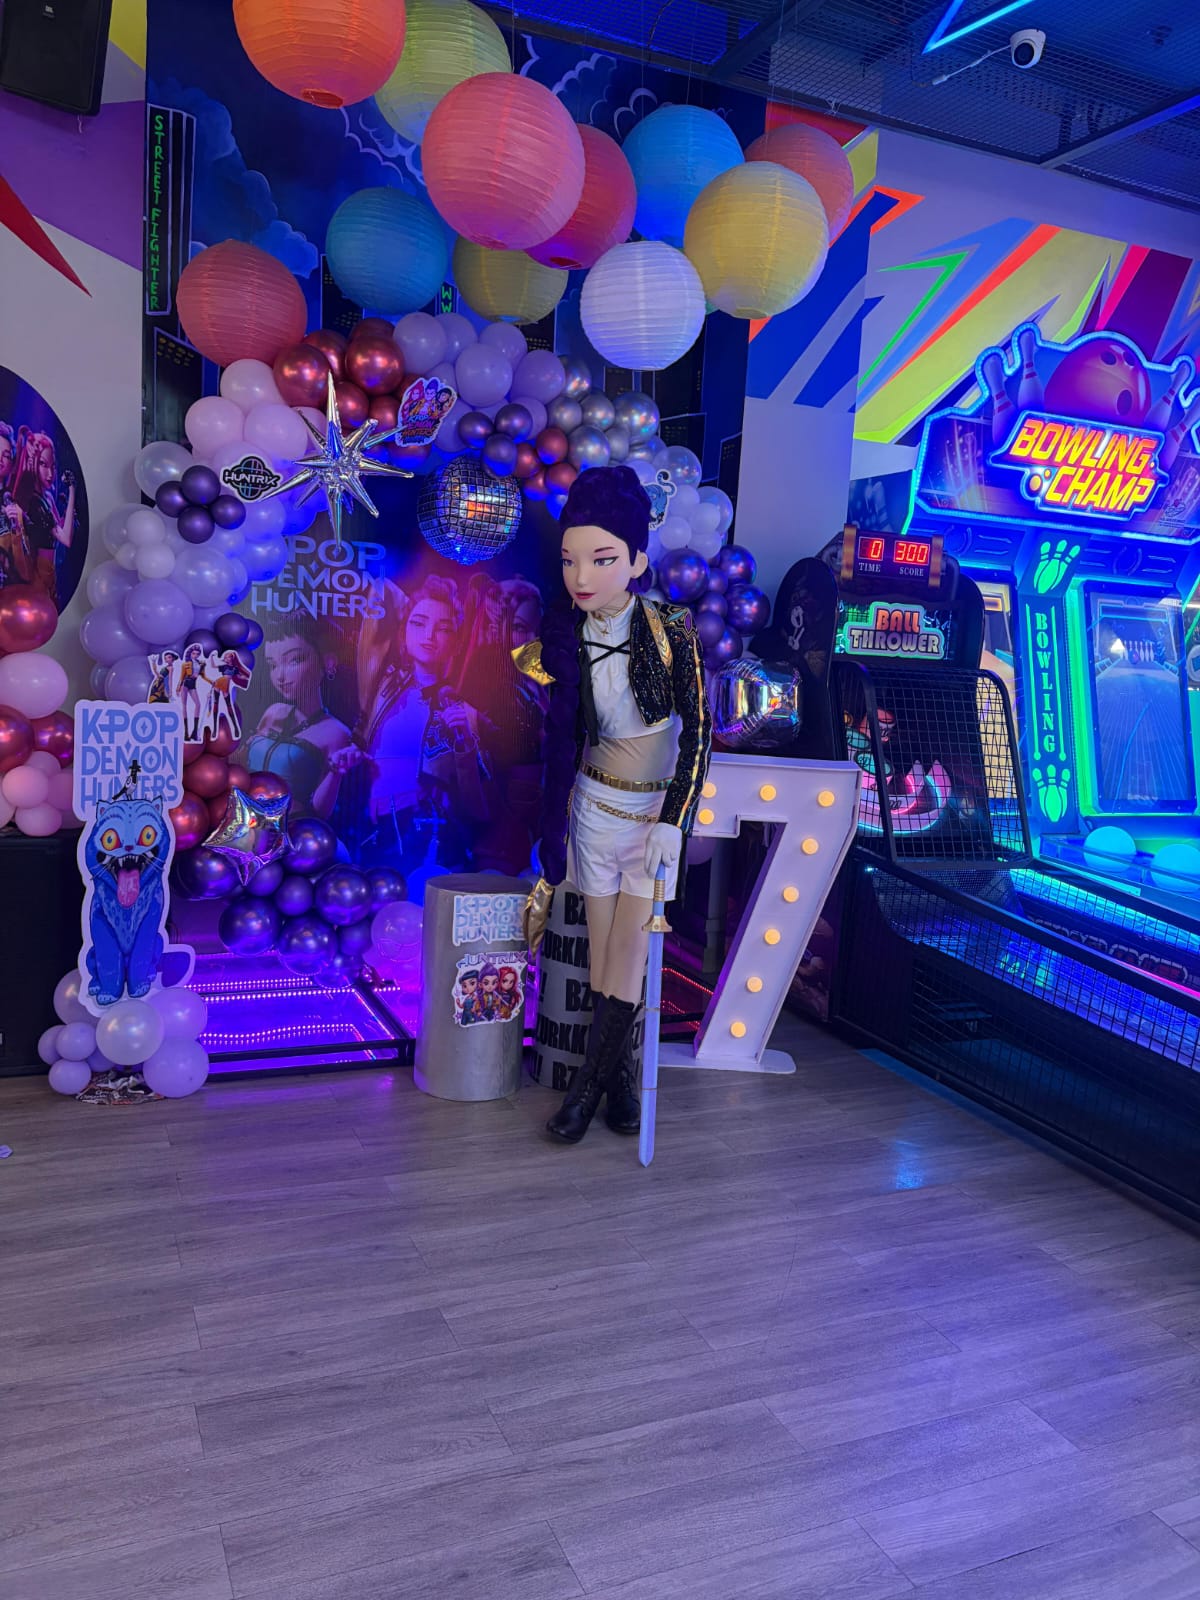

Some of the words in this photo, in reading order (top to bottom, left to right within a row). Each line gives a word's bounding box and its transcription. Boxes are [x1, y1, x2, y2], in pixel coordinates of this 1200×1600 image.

[153, 114, 165, 204] STREET
[150, 207, 162, 310] FIGHTER
[1009, 418, 1157, 475] BOWLING
[1044, 465, 1156, 512] CHAMP
[858, 562, 881, 573] TIME
[899, 566, 924, 577] SCORE
[870, 540, 882, 558] 0
[895, 542, 928, 563] 300
[251, 586, 386, 620] HUNTERS
[252, 565, 386, 602] EMON
[850, 629, 940, 653] THROWER
[875, 609, 921, 634] BALL
[1035, 612, 1056, 753] BOWLING
[81, 737, 179, 779] DEMON
[691, 752, 861, 1064] 7
